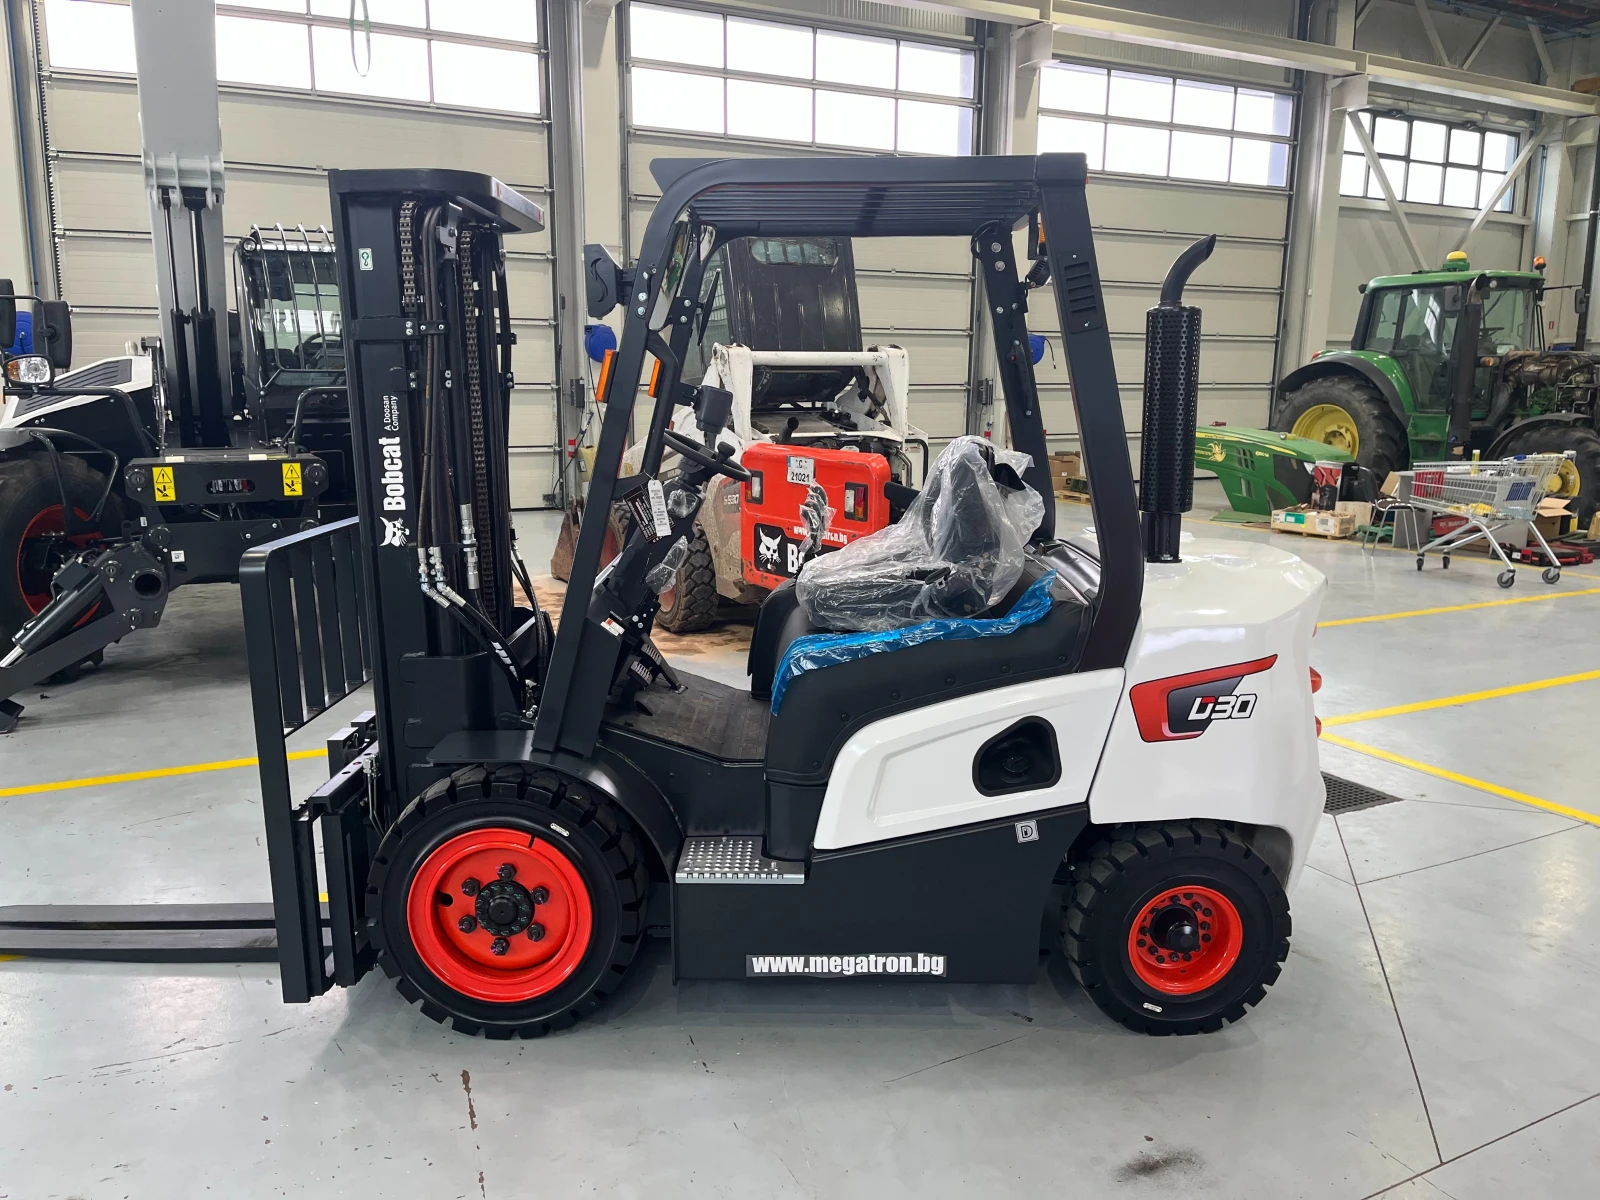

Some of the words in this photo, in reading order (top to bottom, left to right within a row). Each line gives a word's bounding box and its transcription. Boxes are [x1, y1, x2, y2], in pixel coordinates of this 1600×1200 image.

[383, 395, 391, 423] Doosan
[391, 395, 400, 431] Company
[378, 436, 406, 511] Bobcat
[791, 471, 810, 483] 21021
[1187, 694, 1258, 720] D30
[752, 953, 944, 975] www.megatron.bg
